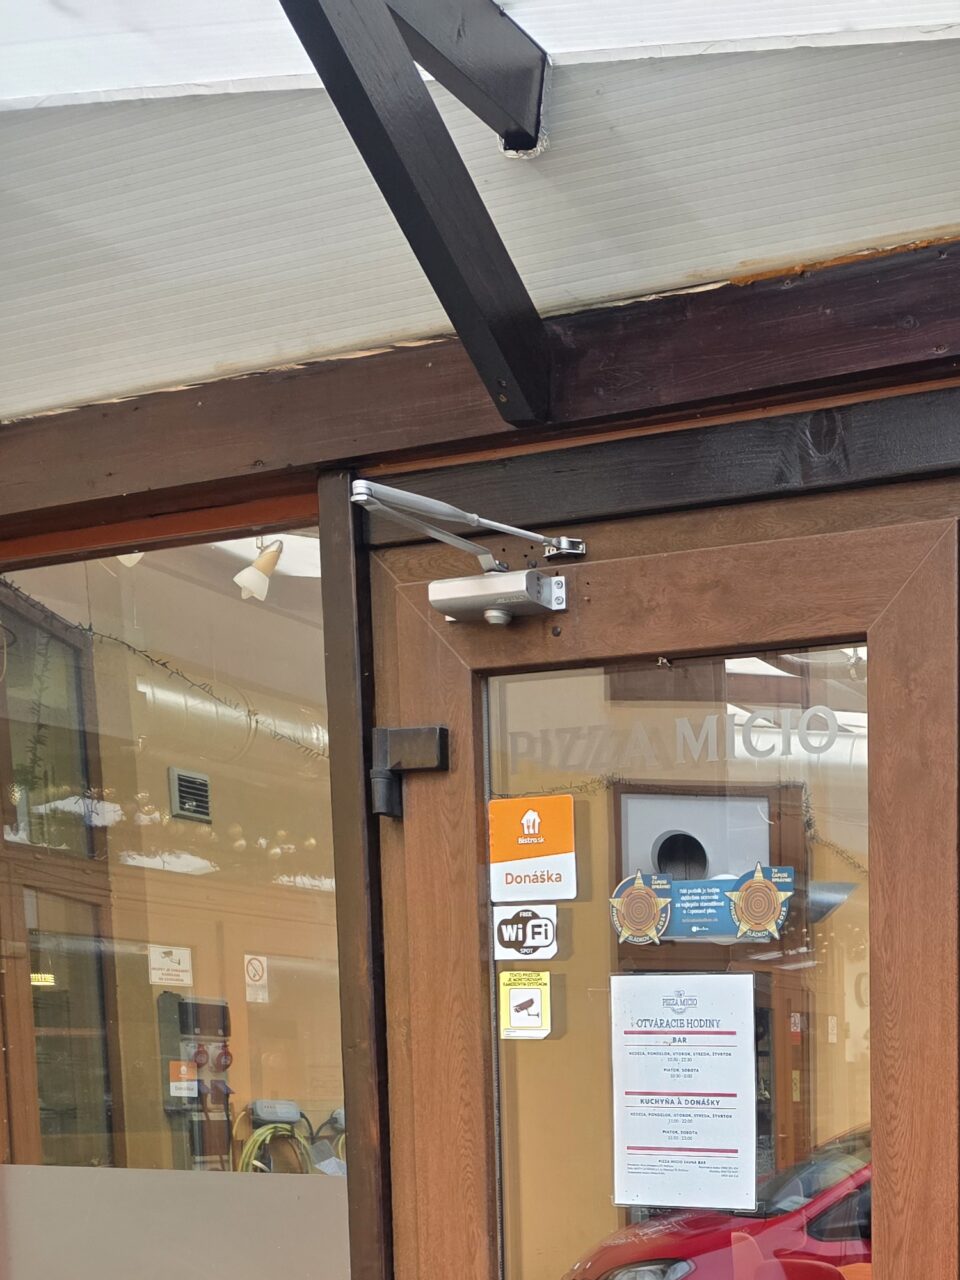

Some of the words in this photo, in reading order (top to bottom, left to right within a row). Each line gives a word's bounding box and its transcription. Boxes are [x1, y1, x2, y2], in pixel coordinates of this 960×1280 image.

[509, 721, 658, 775] PIZZA
[674, 705, 838, 764] MICIO
[505, 870, 562, 885] Donáška
[636, 1018, 685, 1028] OTVÁRACIE
[687, 1019, 721, 1028] HODINY
[640, 1097, 675, 1105] KUCHYŇA
[684, 1098, 720, 1106] DONÁŠKY
